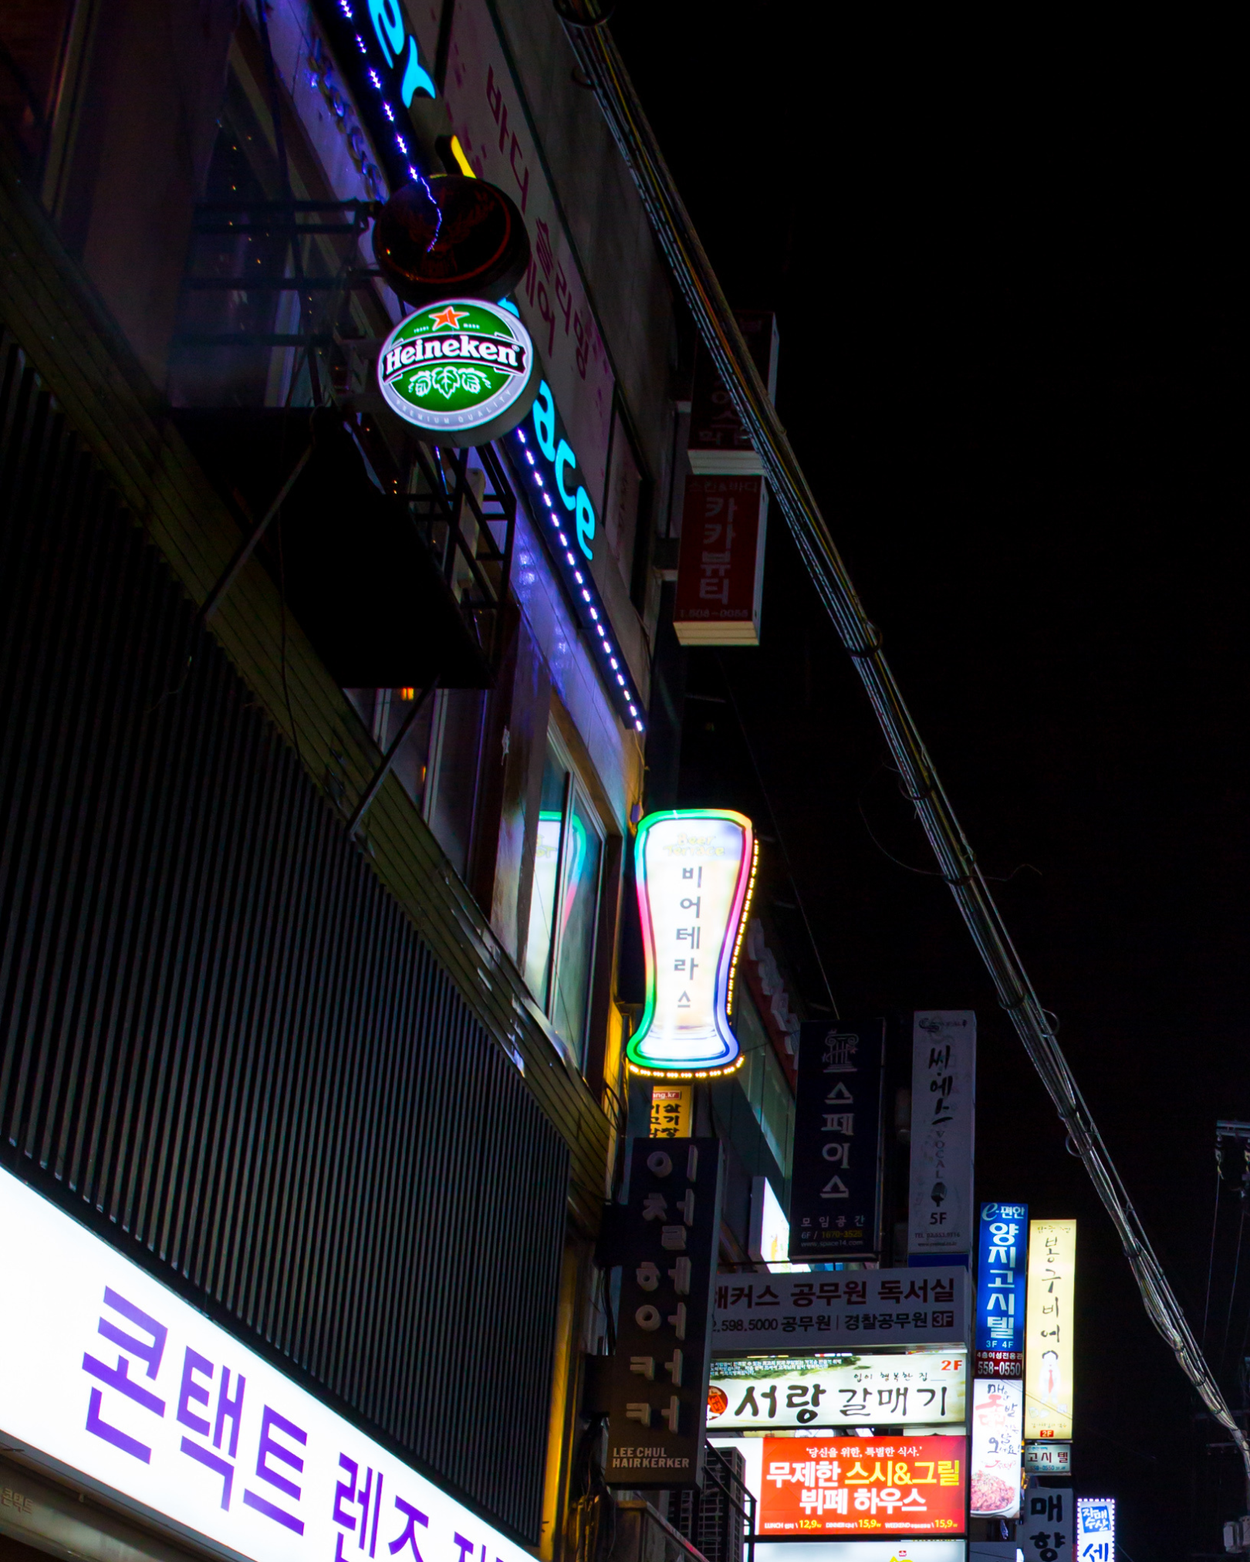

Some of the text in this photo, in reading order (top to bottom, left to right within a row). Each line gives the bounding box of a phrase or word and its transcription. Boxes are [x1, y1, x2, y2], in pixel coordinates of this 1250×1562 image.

[386, 334, 519, 375] Heineken
[664, 845, 726, 857] Terrace
[677, 833, 715, 846] Beer
[673, 865, 703, 1009] 비어테라스
[819, 1081, 855, 1199] 스페이스
[934, 1130, 946, 1179] VOCAL
[929, 1212, 948, 1225] 5F
[790, 1277, 955, 1307] 공무원 독서실
[985, 1222, 1020, 1340] 양지고시텔
[1040, 1236, 1062, 1343] 봉구비어
[781, 1311, 953, 1332] 공무원 경찰공무원 3F
[985, 1340, 1014, 1348] 3F 4F
[940, 1359, 963, 1371] 2F
[977, 1360, 1022, 1376] 558-0550
[81, 1284, 309, 1537] 콘택트
[734, 1383, 948, 1425] 서랑 갈매기
[613, 1448, 667, 1458] LEE CHUL
[864, 1446, 895, 1457] 특별한
[766, 1459, 960, 1488] 무제한 스시&그릴
[799, 1487, 928, 1515] 뷔페 하우스
